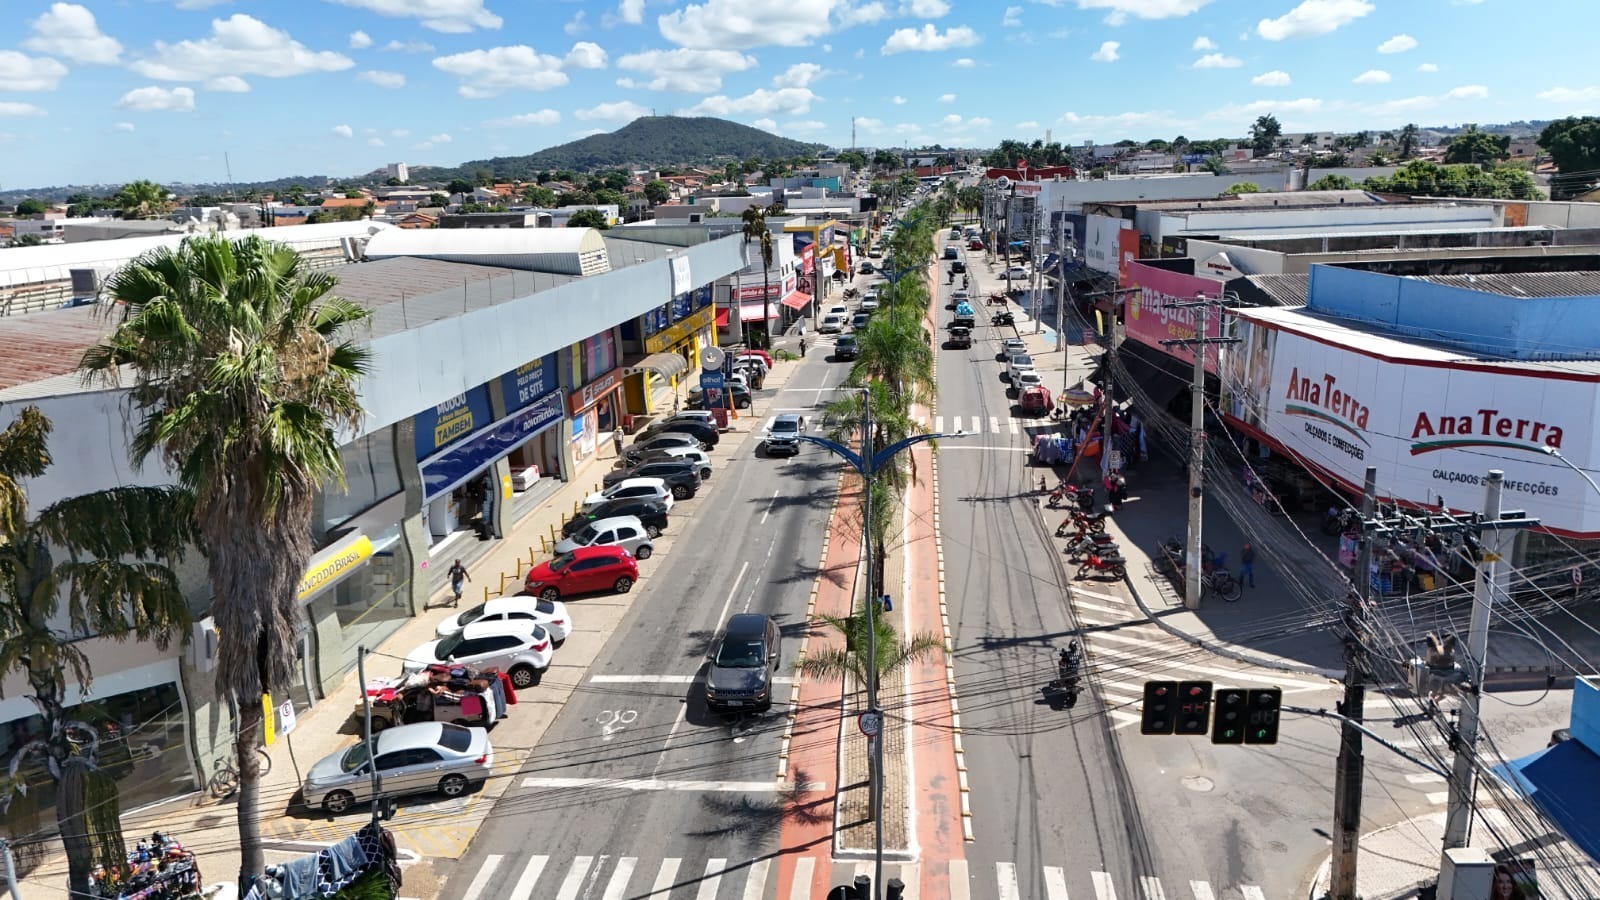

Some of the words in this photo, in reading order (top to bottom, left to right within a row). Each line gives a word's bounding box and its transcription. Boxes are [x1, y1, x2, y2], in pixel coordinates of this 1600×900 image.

[437, 392, 467, 415] MUDOU
[519, 387, 530, 402] DE
[529, 380, 544, 398] SITE
[1286, 367, 1320, 405] Ana
[1323, 373, 1369, 431] Terra
[523, 407, 555, 431] novomundo
[1412, 411, 1472, 438] Ana
[1477, 409, 1563, 448] Terra
[1304, 422, 1327, 442] CALÇADOS
[1327, 433, 1332, 445] E
[1332, 435, 1364, 461] CONFECÇÕES
[1432, 469, 1479, 485] CALÇADOS
[1503, 480, 1559, 496] NFECÇÕES
[334, 551, 360, 572] BRASIL
